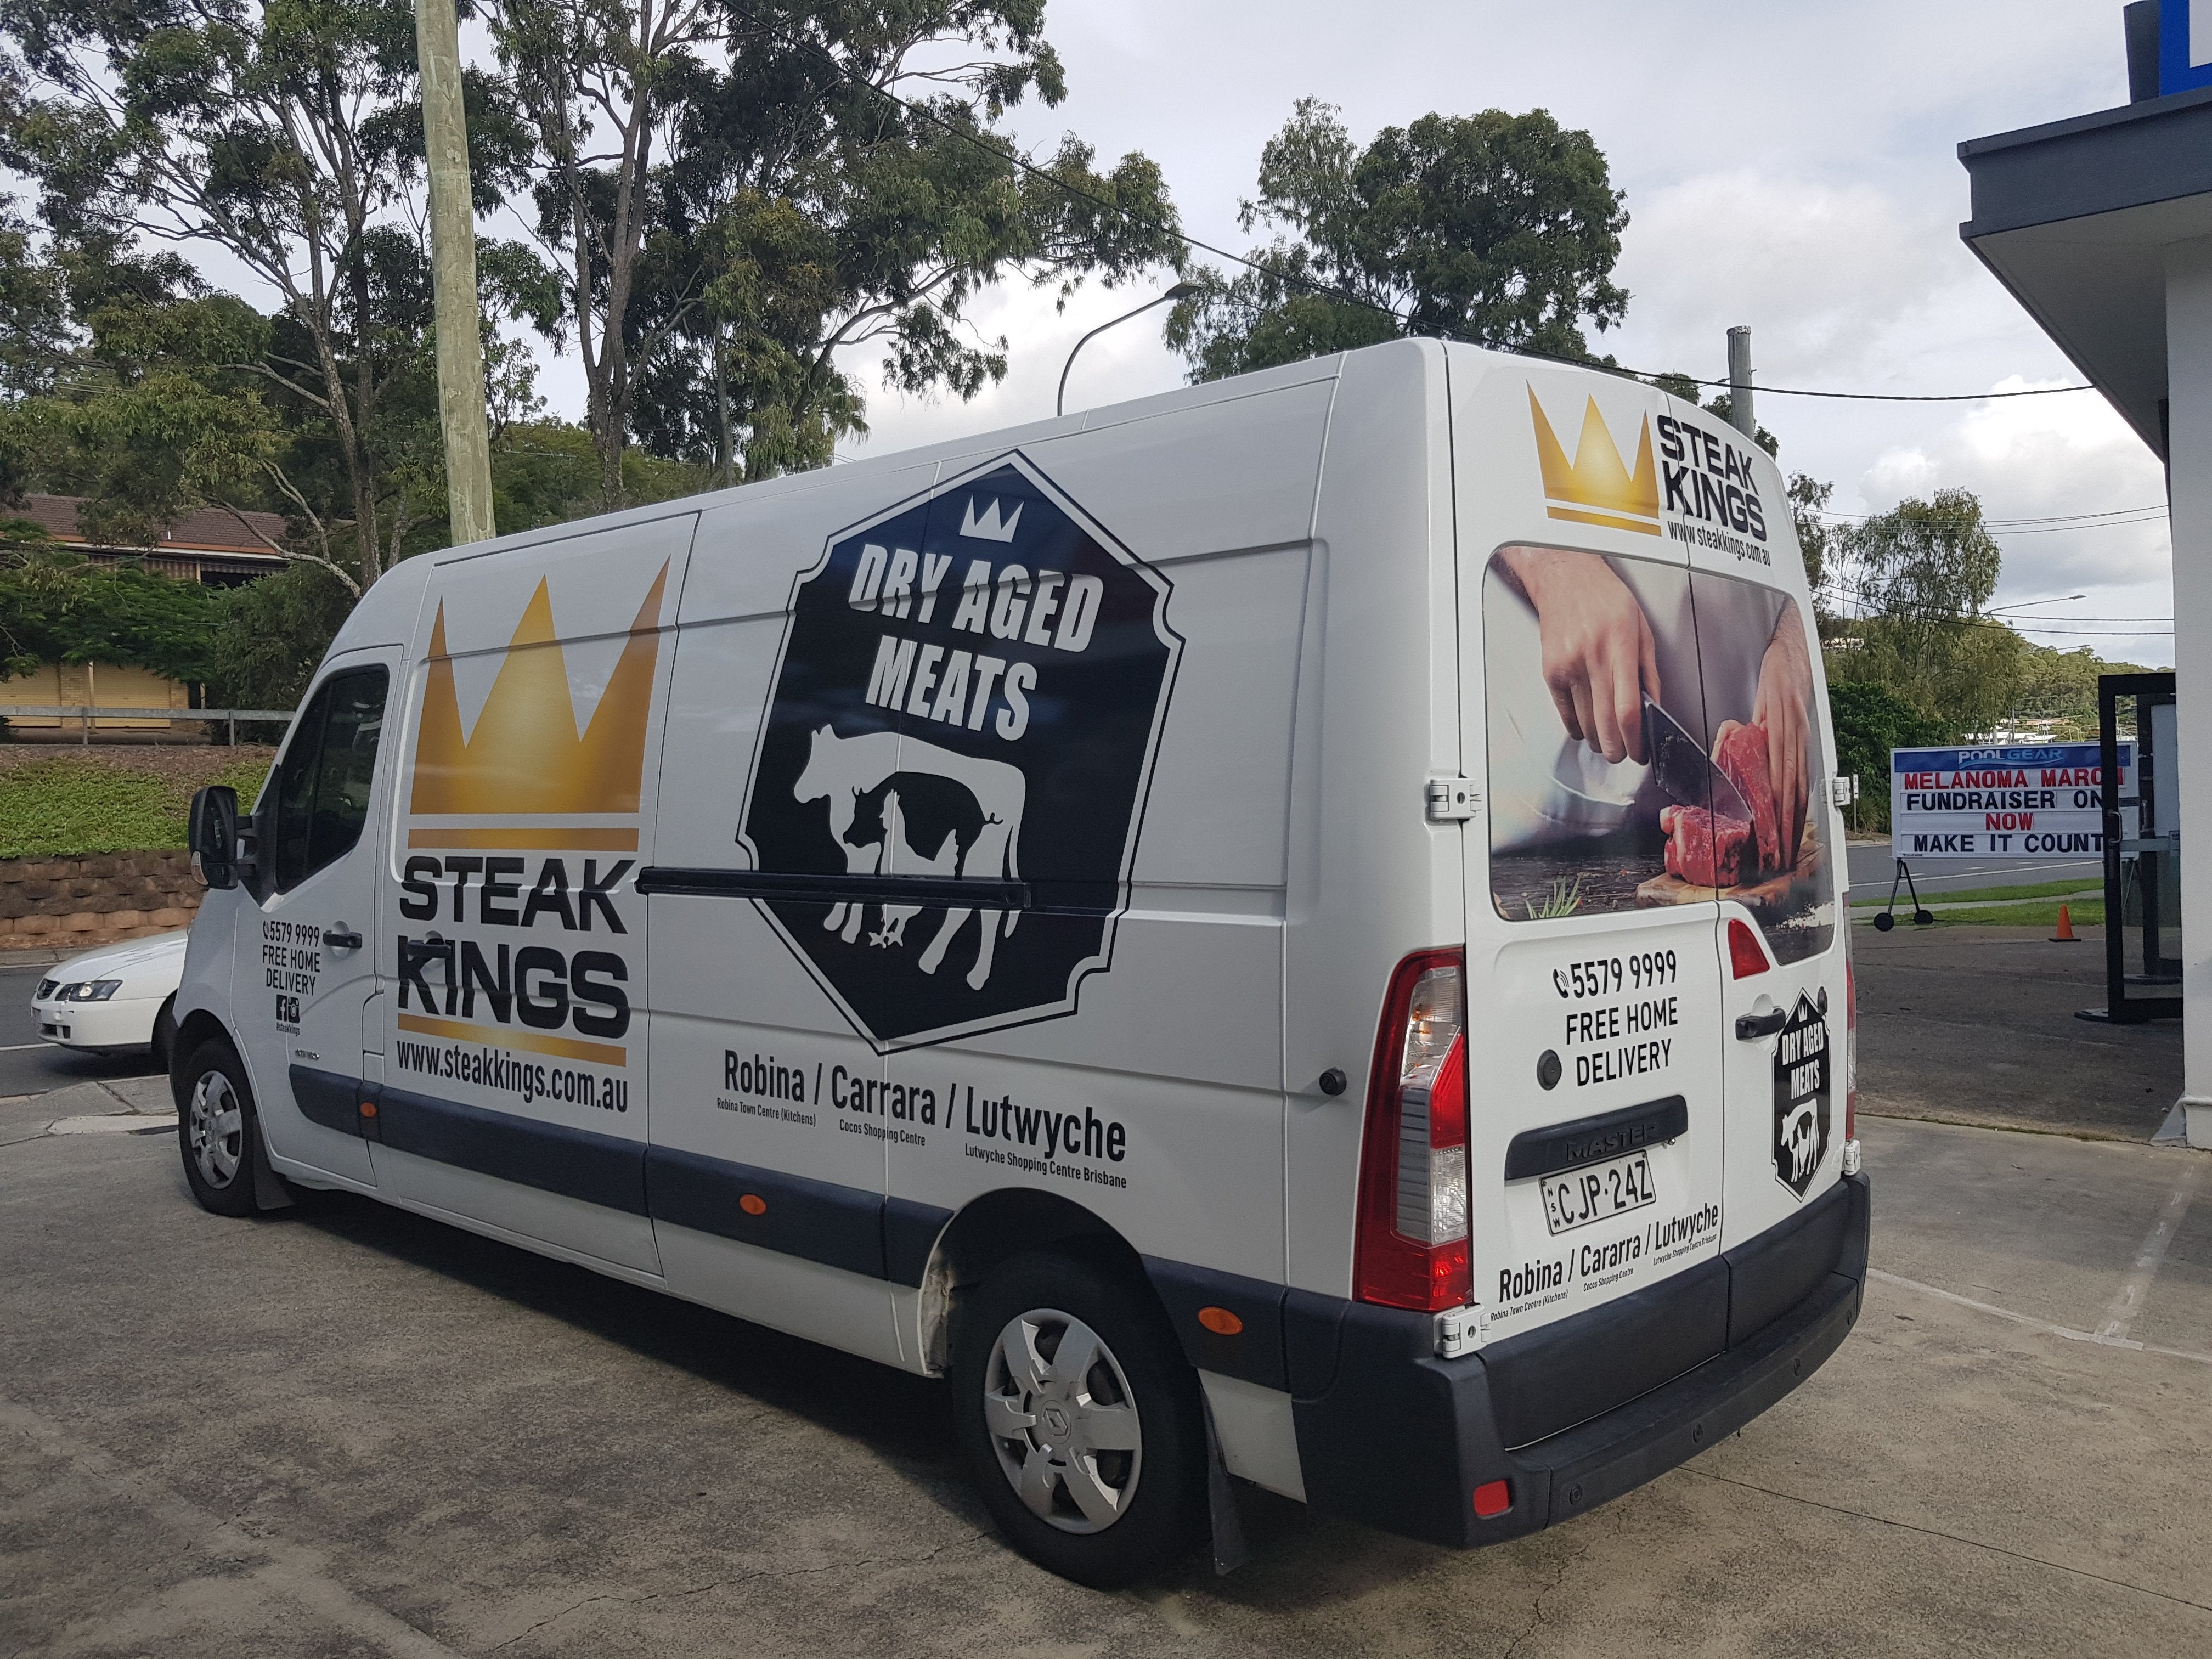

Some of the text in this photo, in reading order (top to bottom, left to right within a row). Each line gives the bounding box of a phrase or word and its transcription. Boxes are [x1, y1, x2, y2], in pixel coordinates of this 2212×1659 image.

[1657, 415, 1760, 496] STEAK
[1661, 460, 1767, 542] KINGS
[848, 543, 1104, 652] DRY AGED
[865, 634, 1038, 741] MEATS
[1958, 748, 2062, 764] POOL GEAR
[1904, 770, 2028, 790] MELANOMA
[1906, 789, 2103, 811] FUNDRAISER ON
[1914, 833, 2103, 853] MAKE IT COUNT
[1985, 812, 2034, 831] NOW
[399, 856, 636, 934] STEAK
[270, 921, 320, 947] 5579 9999
[262, 944, 320, 973] FREE HOME
[1570, 950, 1677, 998] 5579 9999
[266, 968, 316, 996] DELIVERY
[398, 934, 631, 1039] KINGS
[1566, 996, 1679, 1045] FREE HOME
[1576, 1038, 1672, 1087] DELIVERY
[1781, 1021, 1824, 1066] DRY AGED
[397, 1040, 628, 1113] www.steakkings.com.au
[1790, 1059, 1820, 1101] MEATS
[716, 1097, 816, 1127] Robina Town Centre (Kitchens)
[724, 1049, 805, 1103] Robina
[831, 1064, 936, 1125] Carrara
[966, 1086, 1126, 1162] Lutwyche
[839, 1119, 926, 1146] Cocos Shopping Centre
[965, 1143, 1127, 1188] Lutwyche Shopping Centre Brisbane
[1499, 1260, 1562, 1303] Robina
[1580, 1234, 1641, 1277] Cararra
[1655, 1202, 1718, 1251] Lutwyche
[1653, 1252, 1672, 1266] Lutwyche
[1583, 1268, 1634, 1292] Cocos Shopping Centre
[1491, 1289, 1568, 1322] Robina Town Centre (Kitchens)
